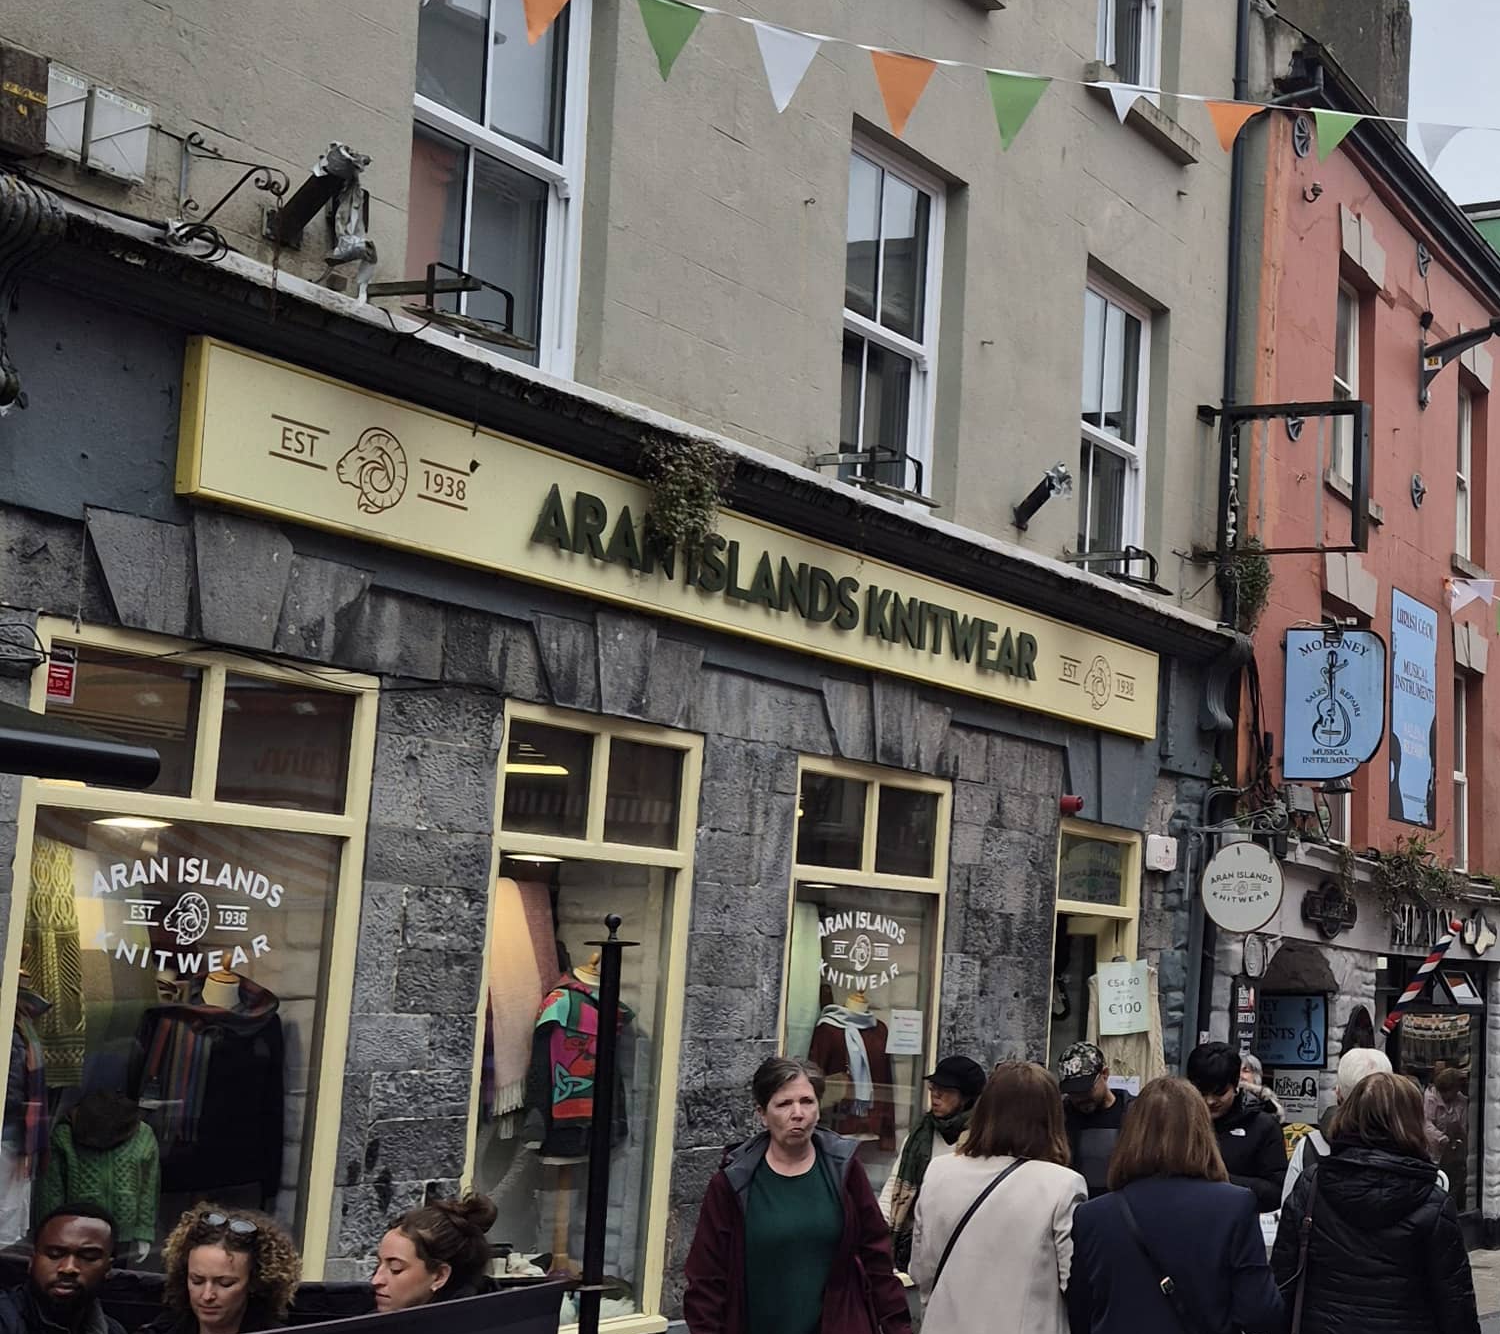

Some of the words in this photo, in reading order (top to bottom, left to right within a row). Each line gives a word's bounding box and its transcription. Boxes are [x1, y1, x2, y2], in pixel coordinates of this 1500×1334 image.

[281, 426, 320, 458] EST
[423, 470, 467, 501] 1938
[684, 532, 860, 631] ISLANDS
[865, 584, 1038, 682] KNITWEAR
[1298, 638, 1369, 658] MOLONEY
[1063, 662, 1077, 679] EST
[1403, 658, 1428, 683] MUSICAL
[1116, 678, 1136, 697] 1938
[1305, 686, 1327, 705] SALES
[1339, 688, 1361, 717] REPAIRS
[1302, 756, 1361, 764] INSTRUMENTS
[1312, 748, 1349, 756] MUSICAL
[92, 857, 169, 897] ARAN
[178, 857, 285, 908] ISLANDS
[1210, 871, 1235, 884] ARAN
[1236, 870, 1273, 884] ISLANDS
[1211, 891, 1271, 903] KNITWEAR
[130, 905, 154, 920] EST
[217, 910, 248, 926] 1938
[817, 911, 853, 940] ARAN
[855, 910, 906, 945] ISLANDS
[92, 926, 272, 974] KNITWEAR
[818, 958, 899, 991] KNITWEAR
[1108, 1001, 1142, 1015] €100
